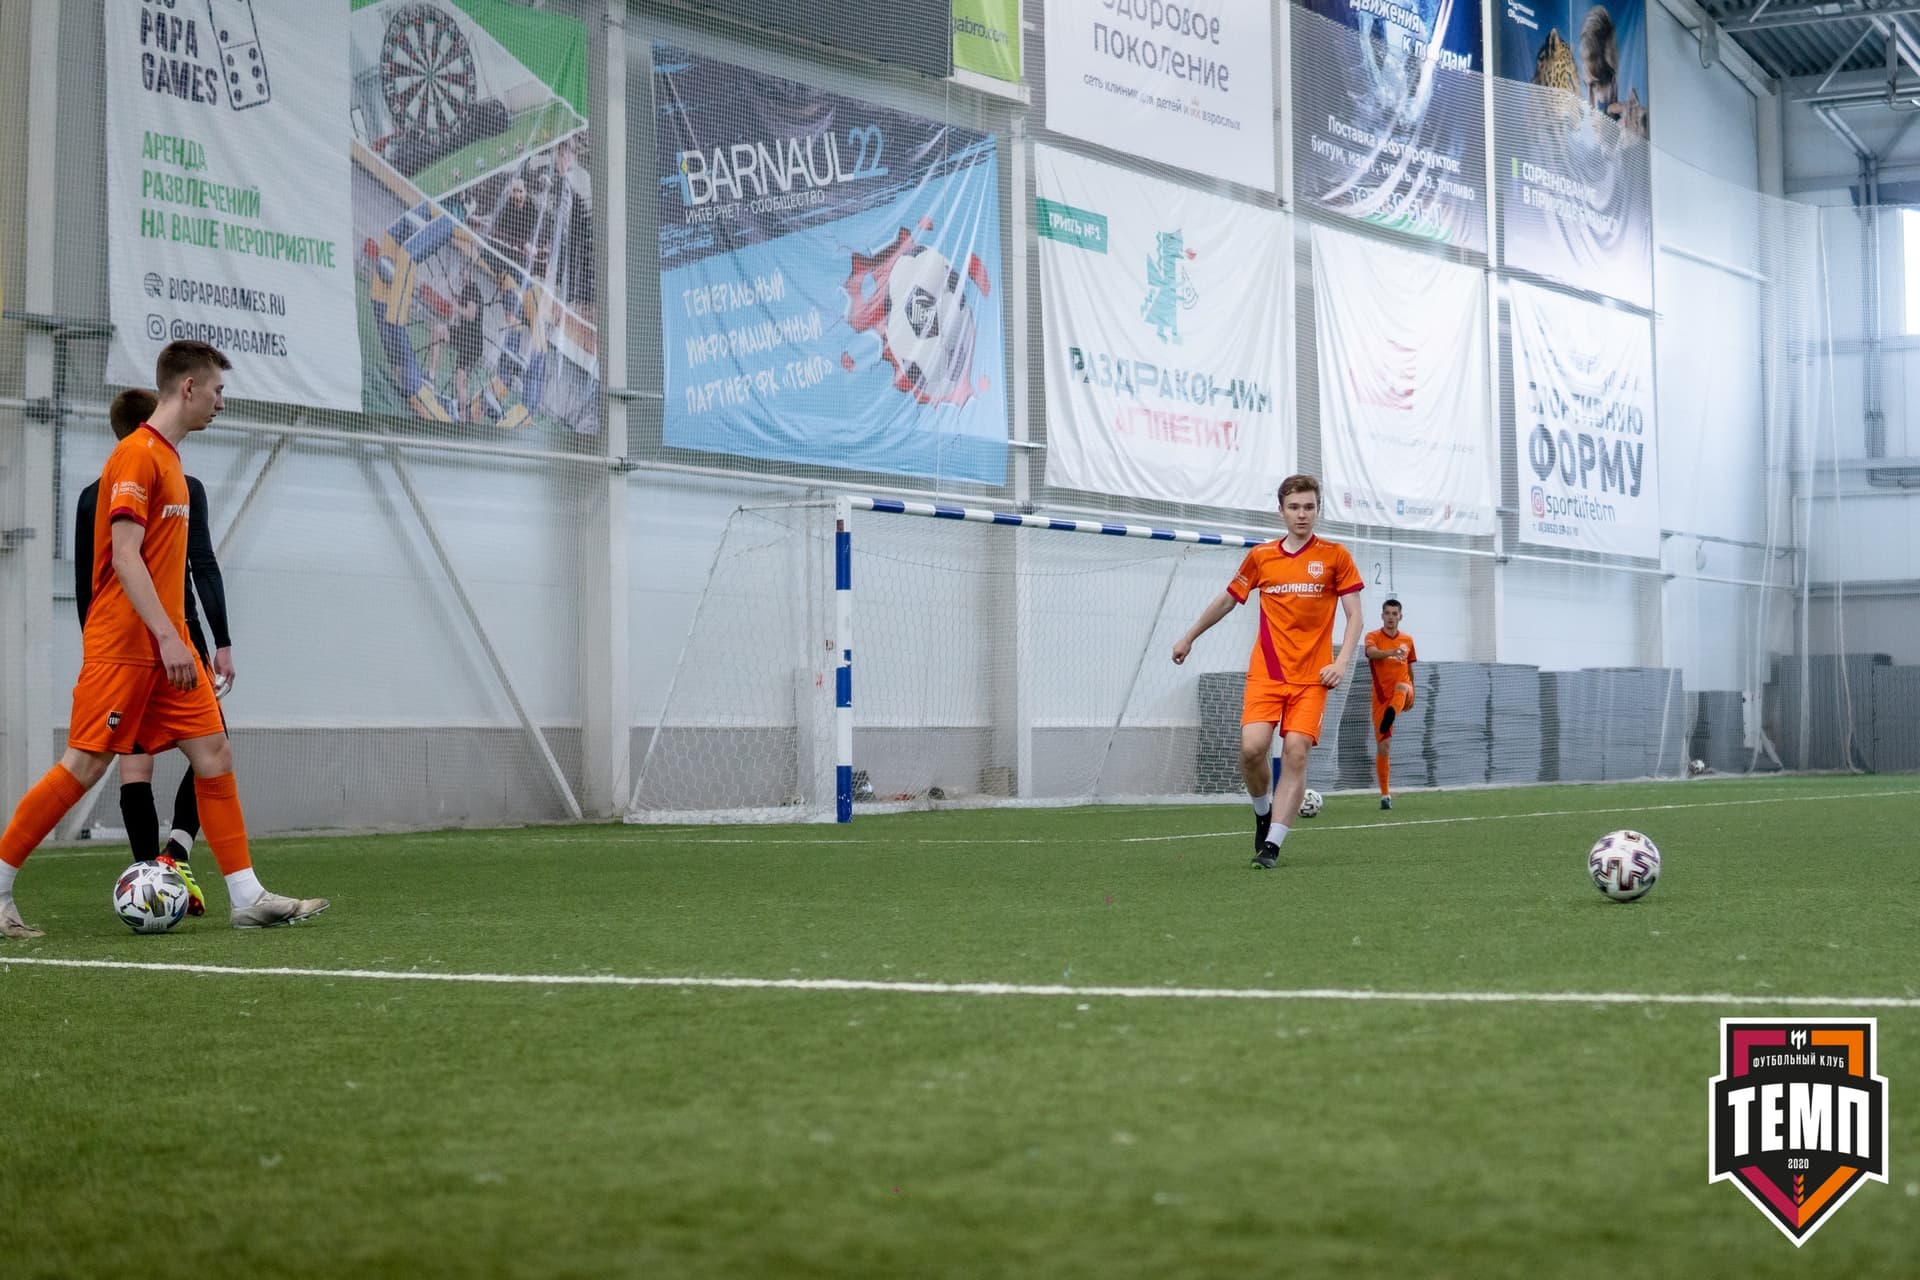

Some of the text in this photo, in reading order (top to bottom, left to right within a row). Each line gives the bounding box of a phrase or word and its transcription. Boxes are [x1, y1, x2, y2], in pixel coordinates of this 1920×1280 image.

[141, 7, 198, 58] PAPA
[1103, 0, 1220, 45] доровое
[141, 52, 218, 105] GAMES
[1094, 22, 1229, 92] поколение
[1083, 73, 1103, 88] сеть
[1156, 97, 1182, 113] детей
[142, 130, 208, 172] АРЕНДА
[1328, 115, 1375, 146] Поставка
[142, 169, 261, 219] РАЗВЛЕЧЕНИЙ
[685, 202, 741, 224] ИНТЕРНЕТ
[750, 189, 825, 215] СООБЩЕСТВО
[141, 208, 336, 269] НА ВАШЕ МЕРОПРИЯТИЕ
[169, 277, 286, 316] BIGPAPAGAMES.RU
[682, 267, 785, 318] ГЕНЕРАЛЬНЫЙ
[170, 319, 288, 357] @BIGPAPAGAMES
[685, 306, 823, 369] ИНФОРМАЦИОННЫЙ
[685, 355, 833, 416] ПАРТНЕР ФК «ТЕМП»
[1069, 346, 1273, 413] РАЗДРАКОНИМ
[1528, 424, 1645, 498] ФОРМУ
[1374, 562, 1382, 585] 2
